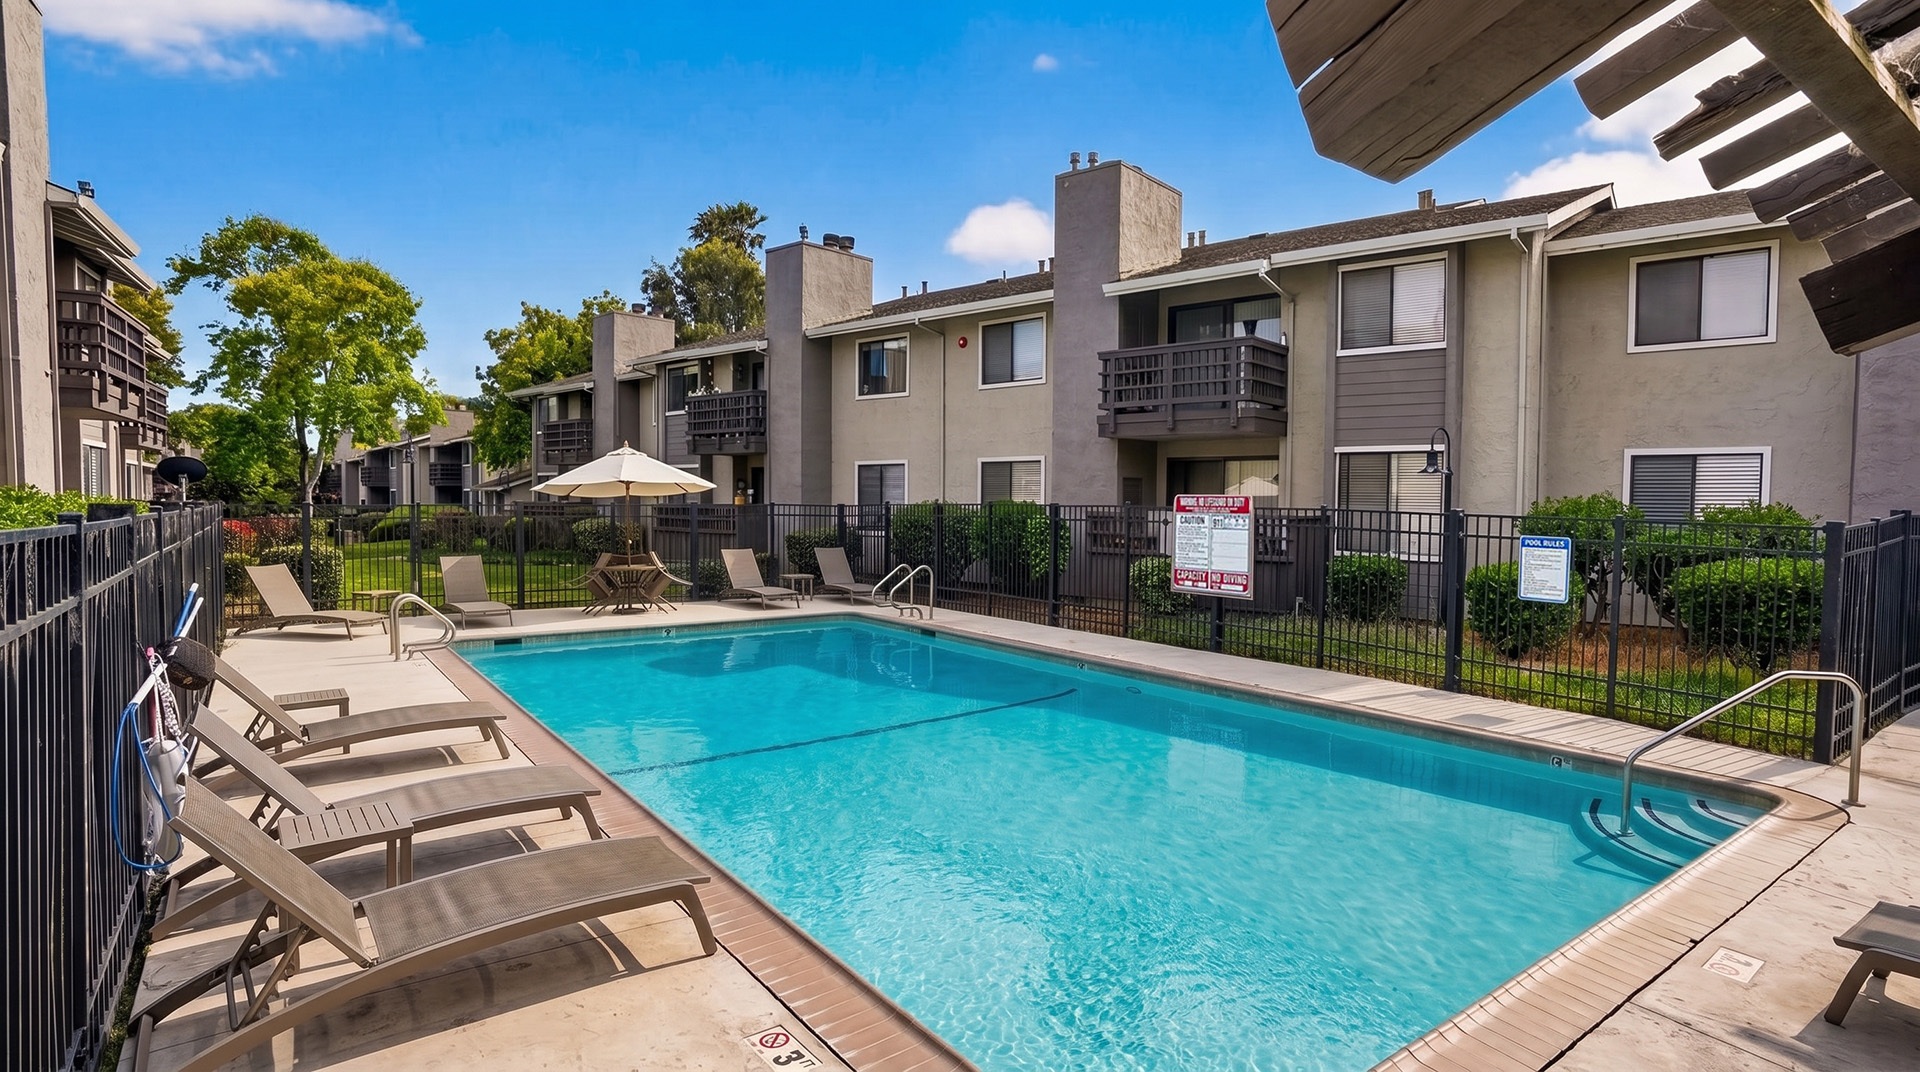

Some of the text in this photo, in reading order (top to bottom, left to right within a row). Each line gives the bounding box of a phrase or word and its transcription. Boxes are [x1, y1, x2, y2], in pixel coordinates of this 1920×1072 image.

[1180, 516, 1205, 525] CAUTION
[1213, 518, 1223, 528] 911
[1525, 539, 1565, 548] POOL RULES
[1177, 570, 1206, 581] CAPACITY
[1211, 573, 1247, 585] NO DIVING
[772, 1049, 806, 1066] 3
